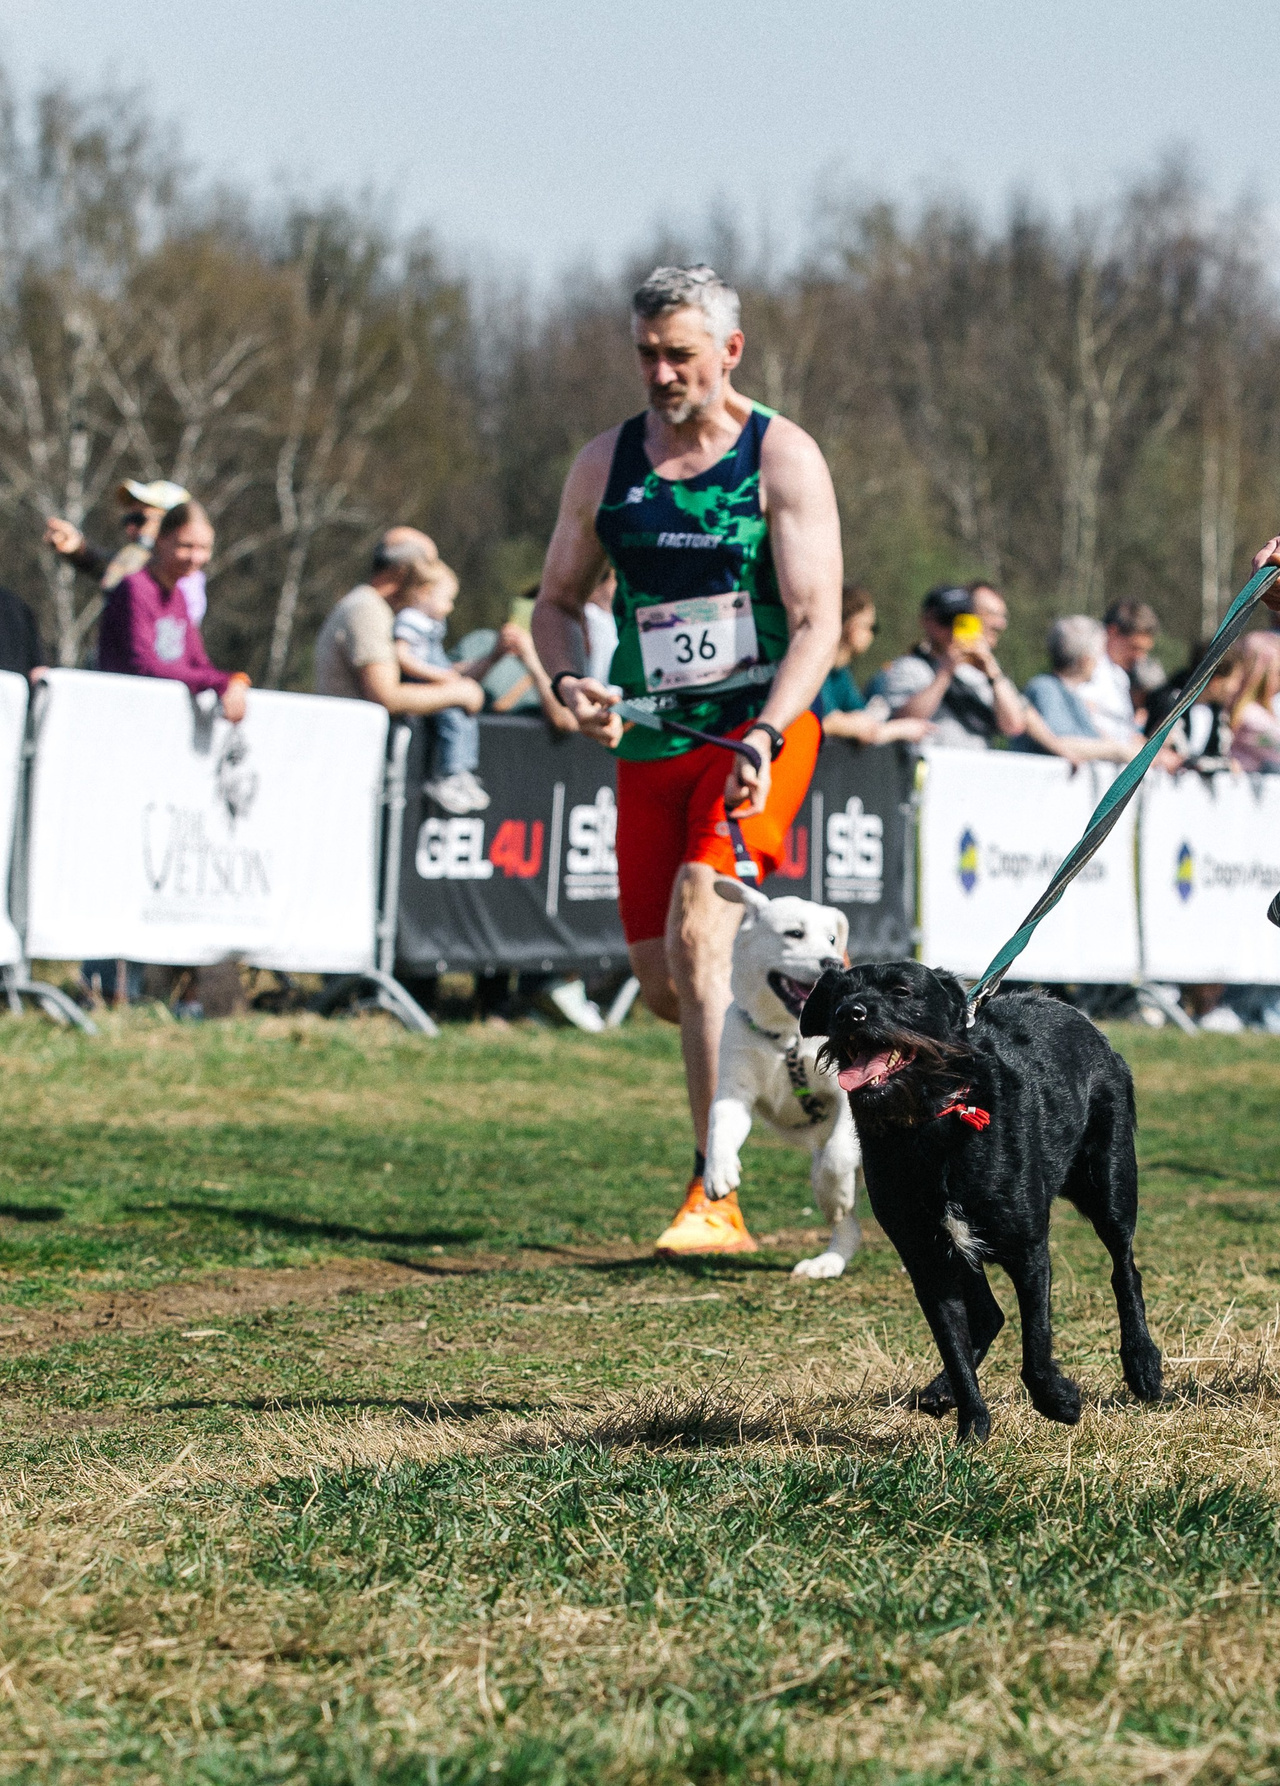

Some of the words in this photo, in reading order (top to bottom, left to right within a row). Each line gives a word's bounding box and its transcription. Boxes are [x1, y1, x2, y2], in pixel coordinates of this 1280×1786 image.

[657, 532, 723, 548] FACTORY
[674, 630, 716, 664] 36
[416, 817, 544, 880] GEL4U
